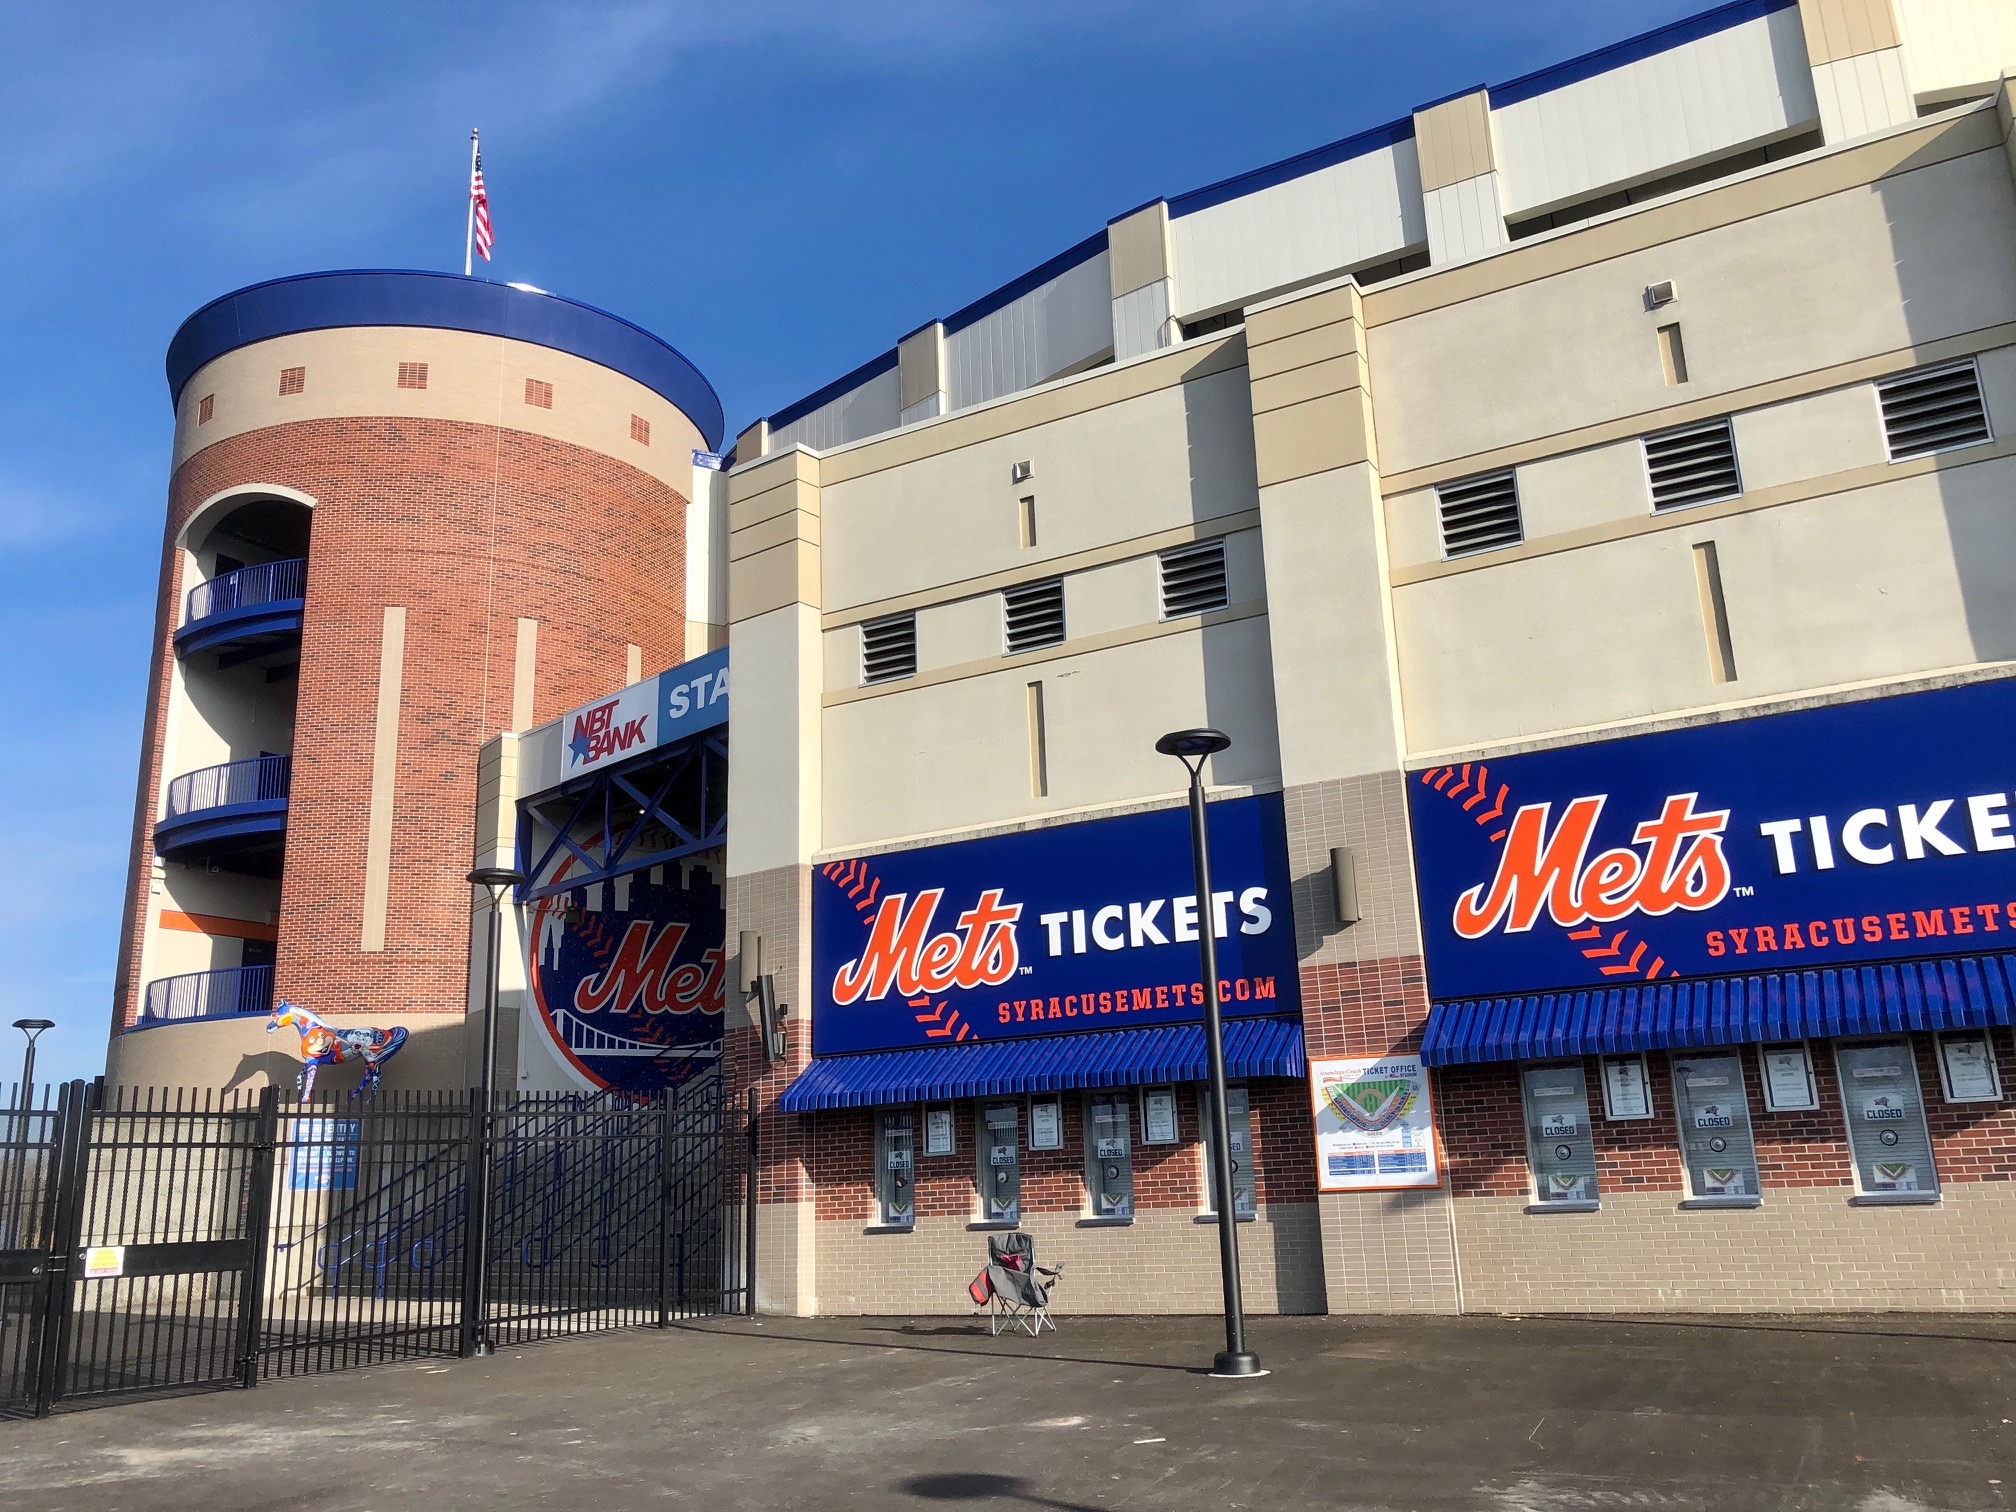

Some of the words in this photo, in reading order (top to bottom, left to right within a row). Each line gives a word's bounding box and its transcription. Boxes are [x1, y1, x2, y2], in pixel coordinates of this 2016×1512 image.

[572, 699, 620, 743] NBT
[582, 714, 650, 766] BANK
[1760, 791, 2016, 875] TICKE
[1452, 792, 1732, 940] Mets
[1040, 886, 1273, 957] TICKETS
[832, 887, 1024, 1006] Mets
[998, 976, 1276, 1024] SYRACUSEMETSCOM
[1362, 1066, 1389, 1076] TICKET
[1390, 1064, 1417, 1074] OFFICE
[1697, 1116, 1731, 1127] CLOSED
[1866, 1108, 1903, 1119] CLOSED
[1544, 1125, 1575, 1136] CLOSED
[889, 1160, 910, 1169] CLOSED
[992, 1156, 1014, 1165] CLOSED
[1099, 1148, 1123, 1158] CLOSED
